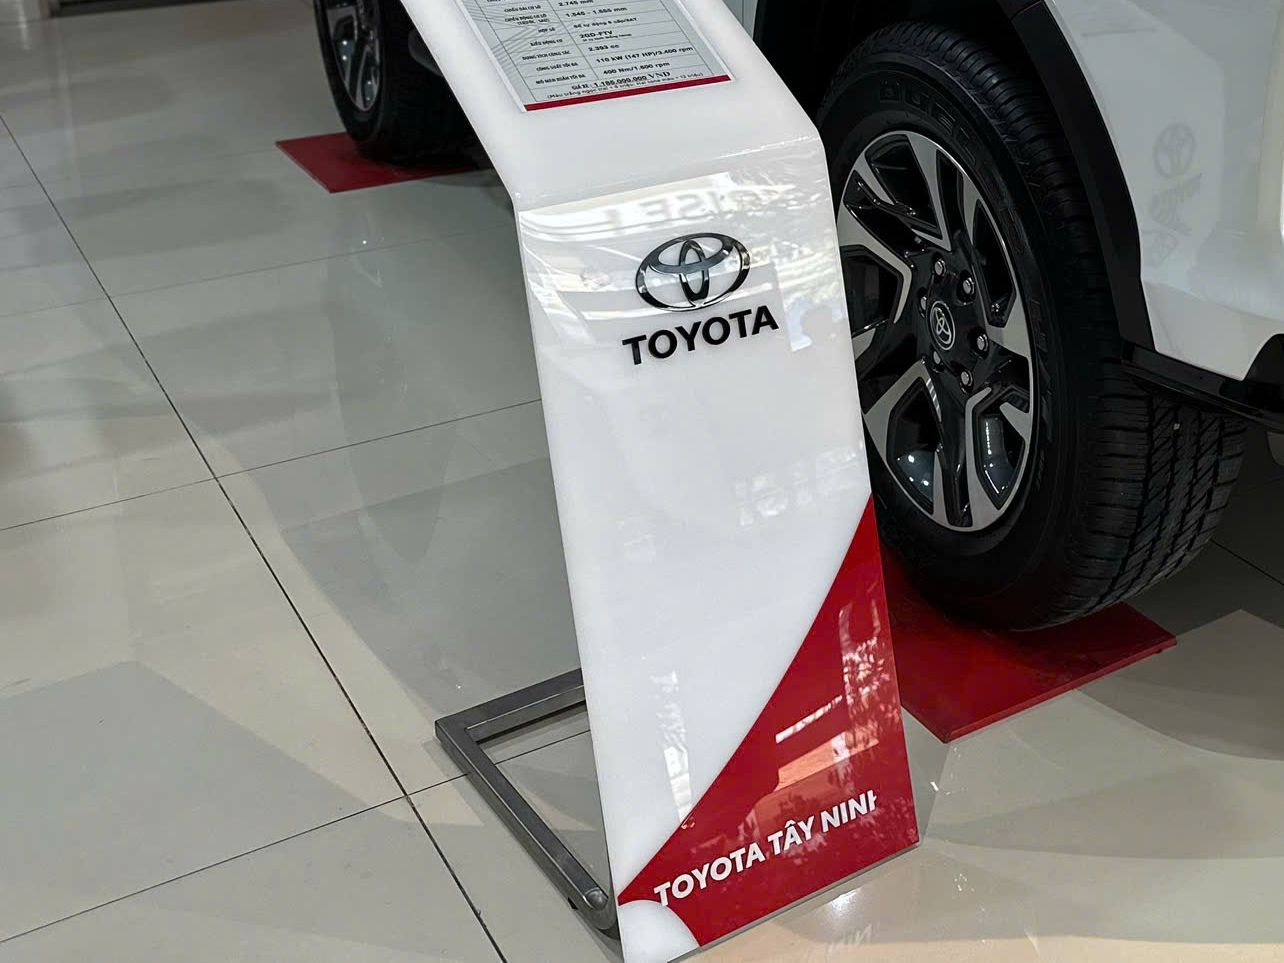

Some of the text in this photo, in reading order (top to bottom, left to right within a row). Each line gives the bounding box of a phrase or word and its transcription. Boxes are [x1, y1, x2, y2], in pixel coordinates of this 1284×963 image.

[622, 305, 779, 365] TOYOTA
[654, 843, 766, 907] TOYOTA
[767, 813, 816, 856] TÂY
